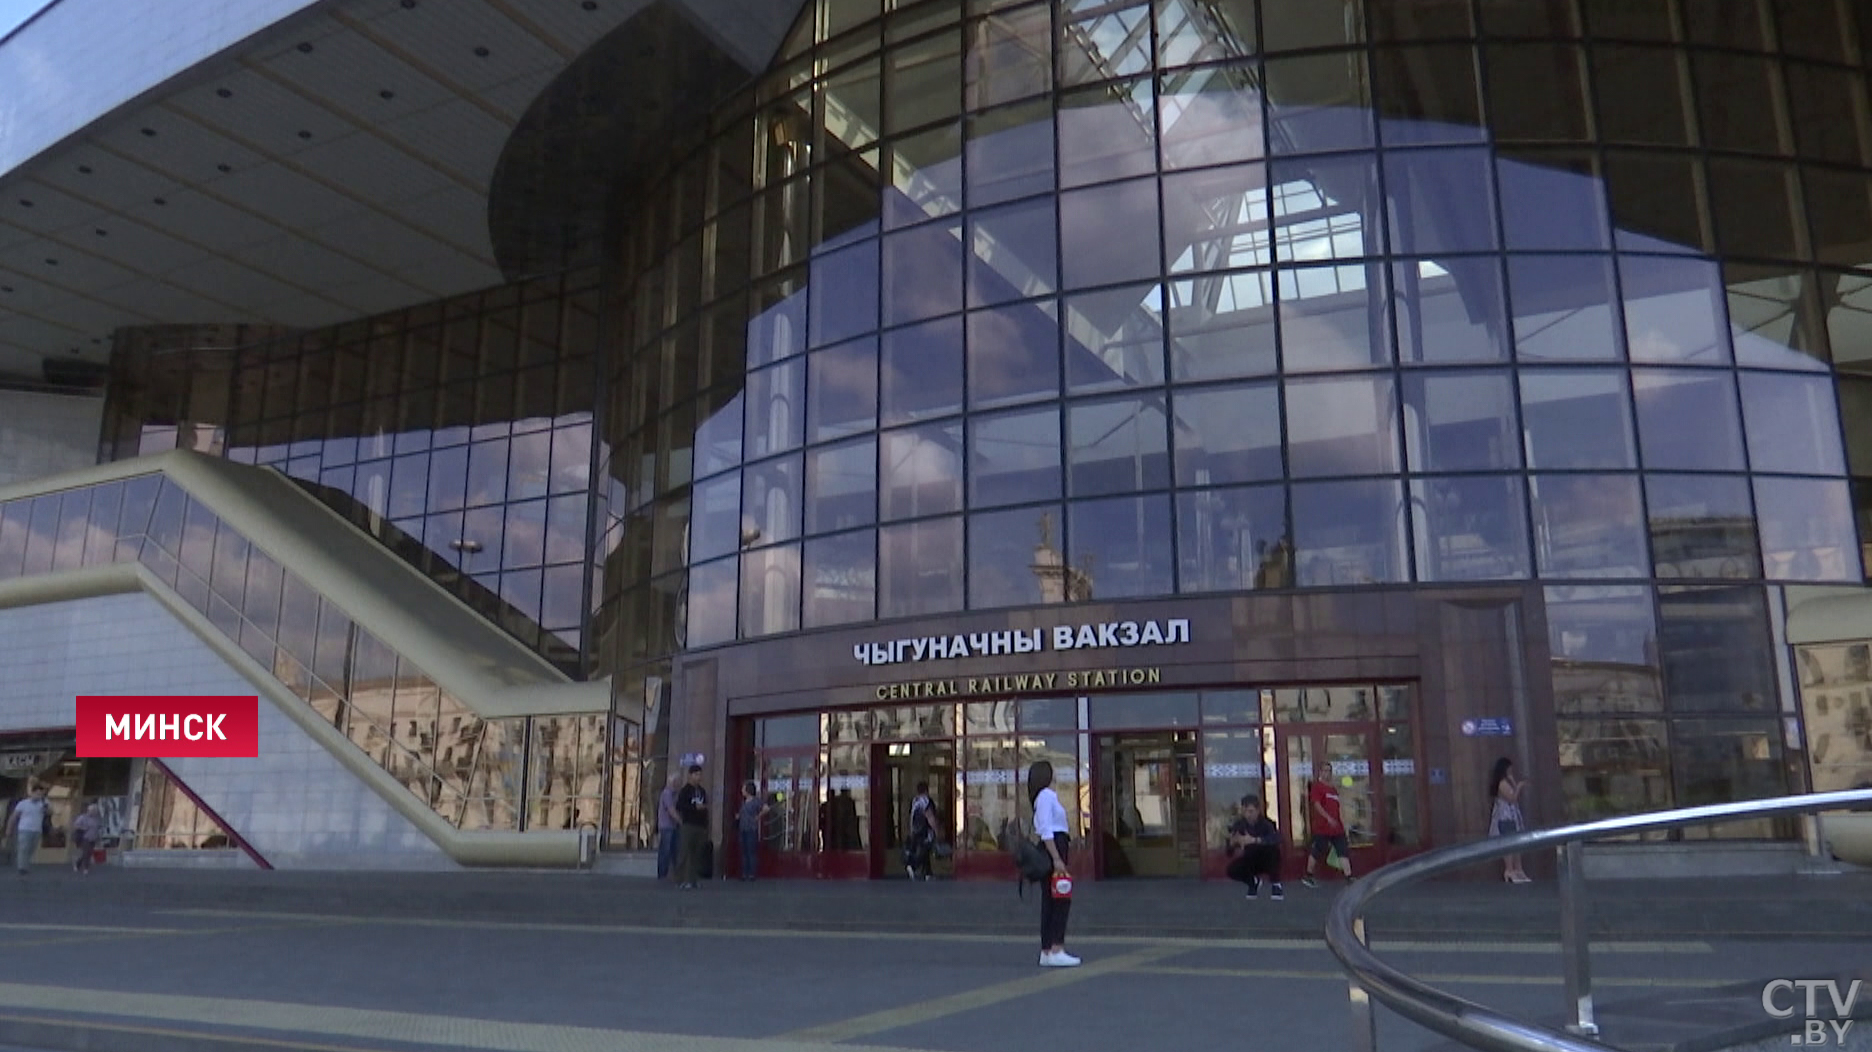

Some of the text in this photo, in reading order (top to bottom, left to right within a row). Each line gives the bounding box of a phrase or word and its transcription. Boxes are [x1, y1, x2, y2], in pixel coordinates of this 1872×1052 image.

[854, 619, 1191, 666] ЧЫГУНАЧНЫ ВАКЗАЛ
[876, 667, 1161, 700] CENTRAL RAILWAY STATION
